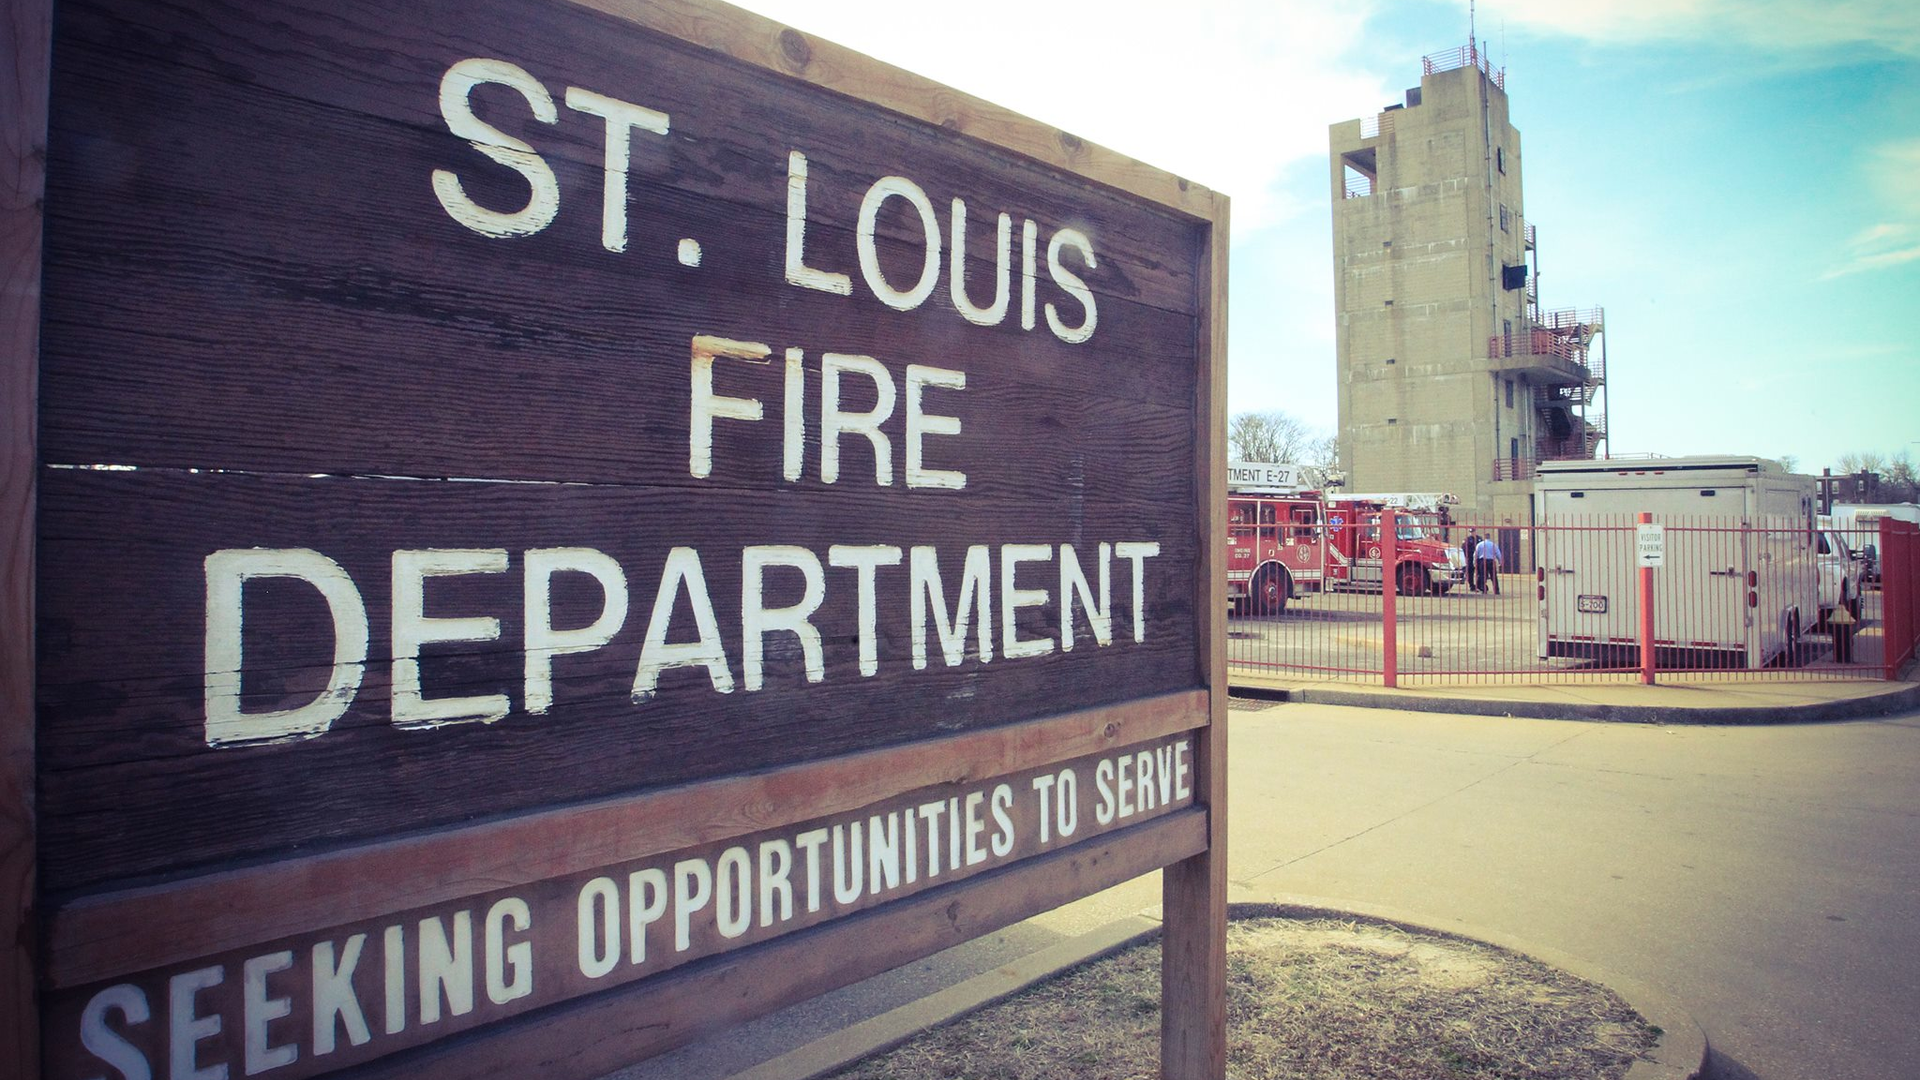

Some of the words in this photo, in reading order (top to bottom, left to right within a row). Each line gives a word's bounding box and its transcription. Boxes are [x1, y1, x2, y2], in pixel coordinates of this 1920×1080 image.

[431, 57, 702, 268] ST.
[784, 150, 1098, 344] LOUIS
[689, 334, 967, 489] FIRE
[1266, 470, 1290, 483] E-27
[1639, 543, 1663, 552] PARKING
[1640, 533, 1661, 542] VISITOR
[204, 541, 1161, 750] DEPARTMENT
[80, 897, 534, 1080] SEEKING
[577, 783, 1015, 980] OPPORTUNITIES
[1032, 768, 1079, 845] TO
[1095, 740, 1192, 827] SERVE
